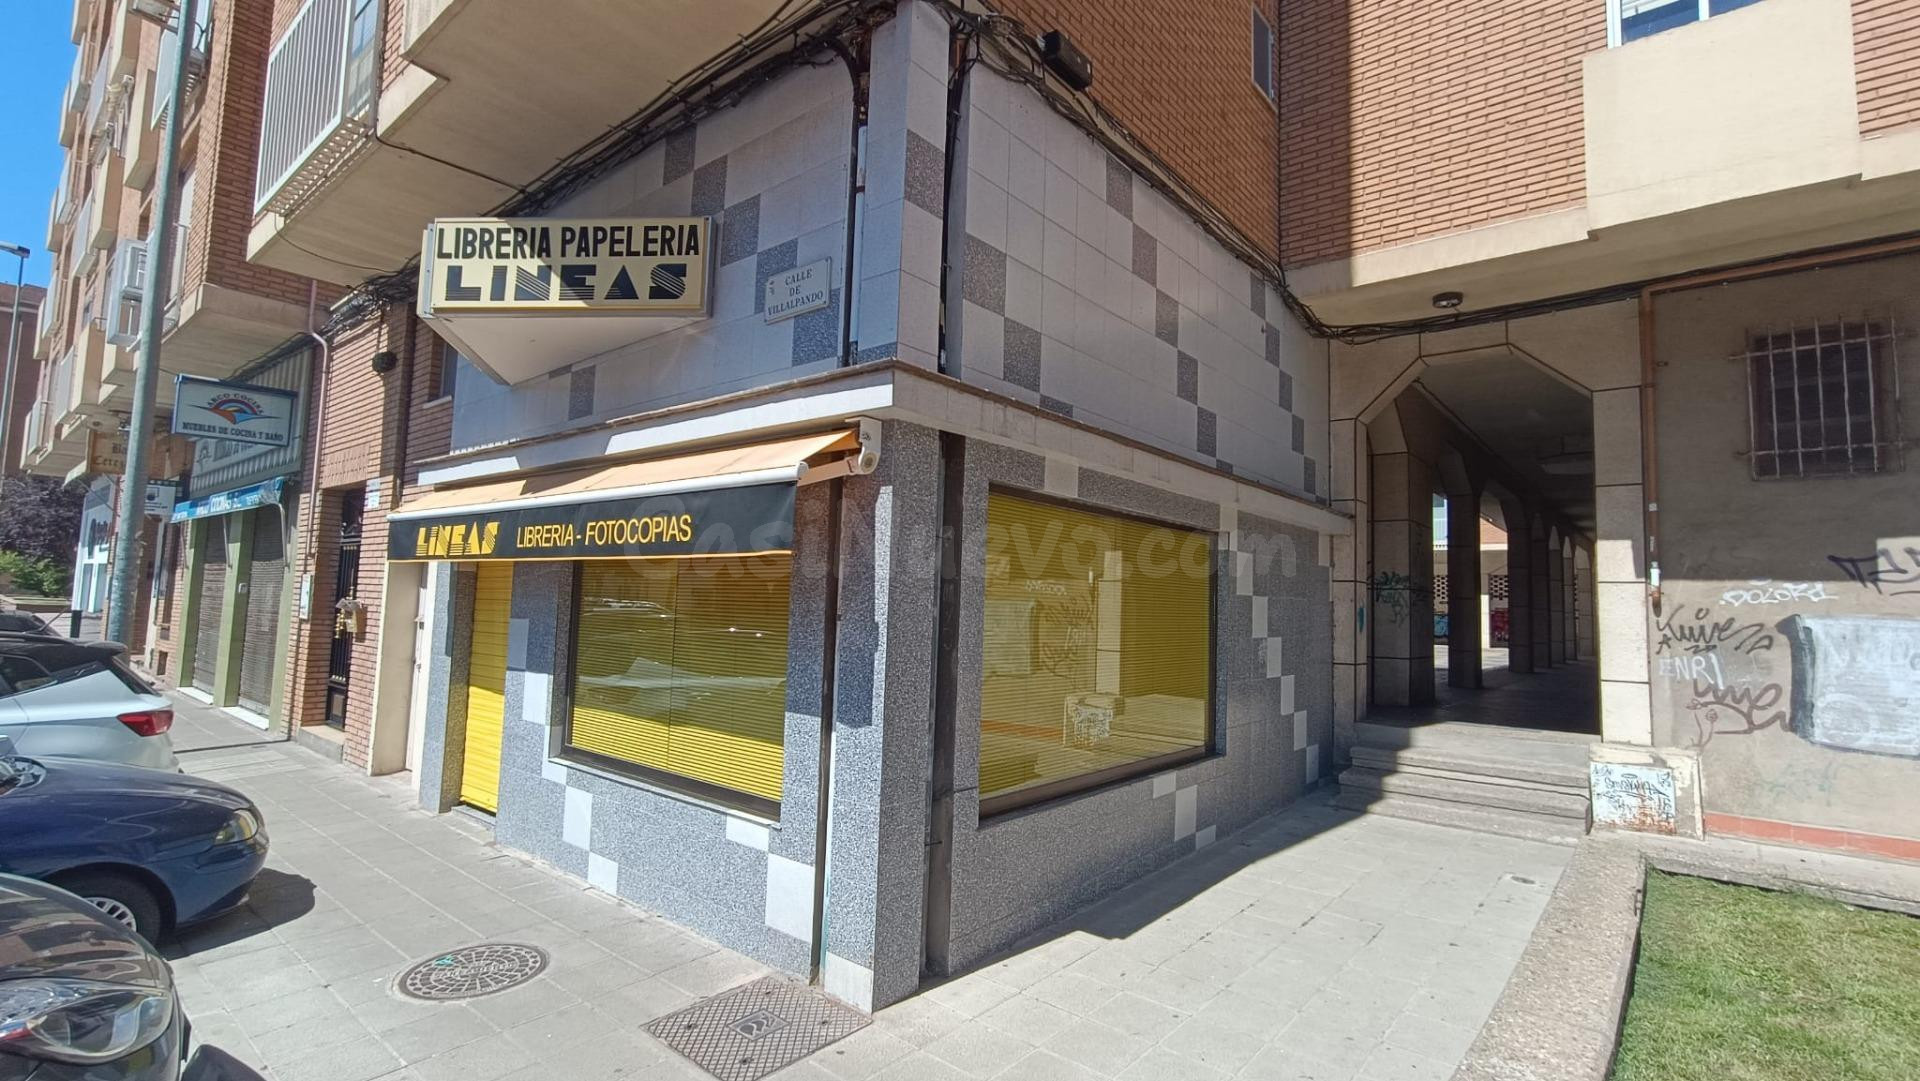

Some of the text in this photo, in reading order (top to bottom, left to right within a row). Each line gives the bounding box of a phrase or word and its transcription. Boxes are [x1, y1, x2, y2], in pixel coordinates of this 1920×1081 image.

[436, 224, 700, 260] LIBRERIA PAPELERIA
[445, 263, 687, 301] LINEAS
[785, 268, 812, 286] CALLE
[789, 285, 801, 297] DE
[767, 290, 824, 316] VILLALPANDO
[182, 421, 217, 435] MUEBLES
[218, 425, 229, 435] DE
[230, 427, 257, 440] COCINA
[258, 430, 264, 440] Y
[415, 520, 500, 558] LINEAS
[516, 524, 574, 548] LIBRERIA
[585, 514, 693, 546] FOTOCOPIAS
